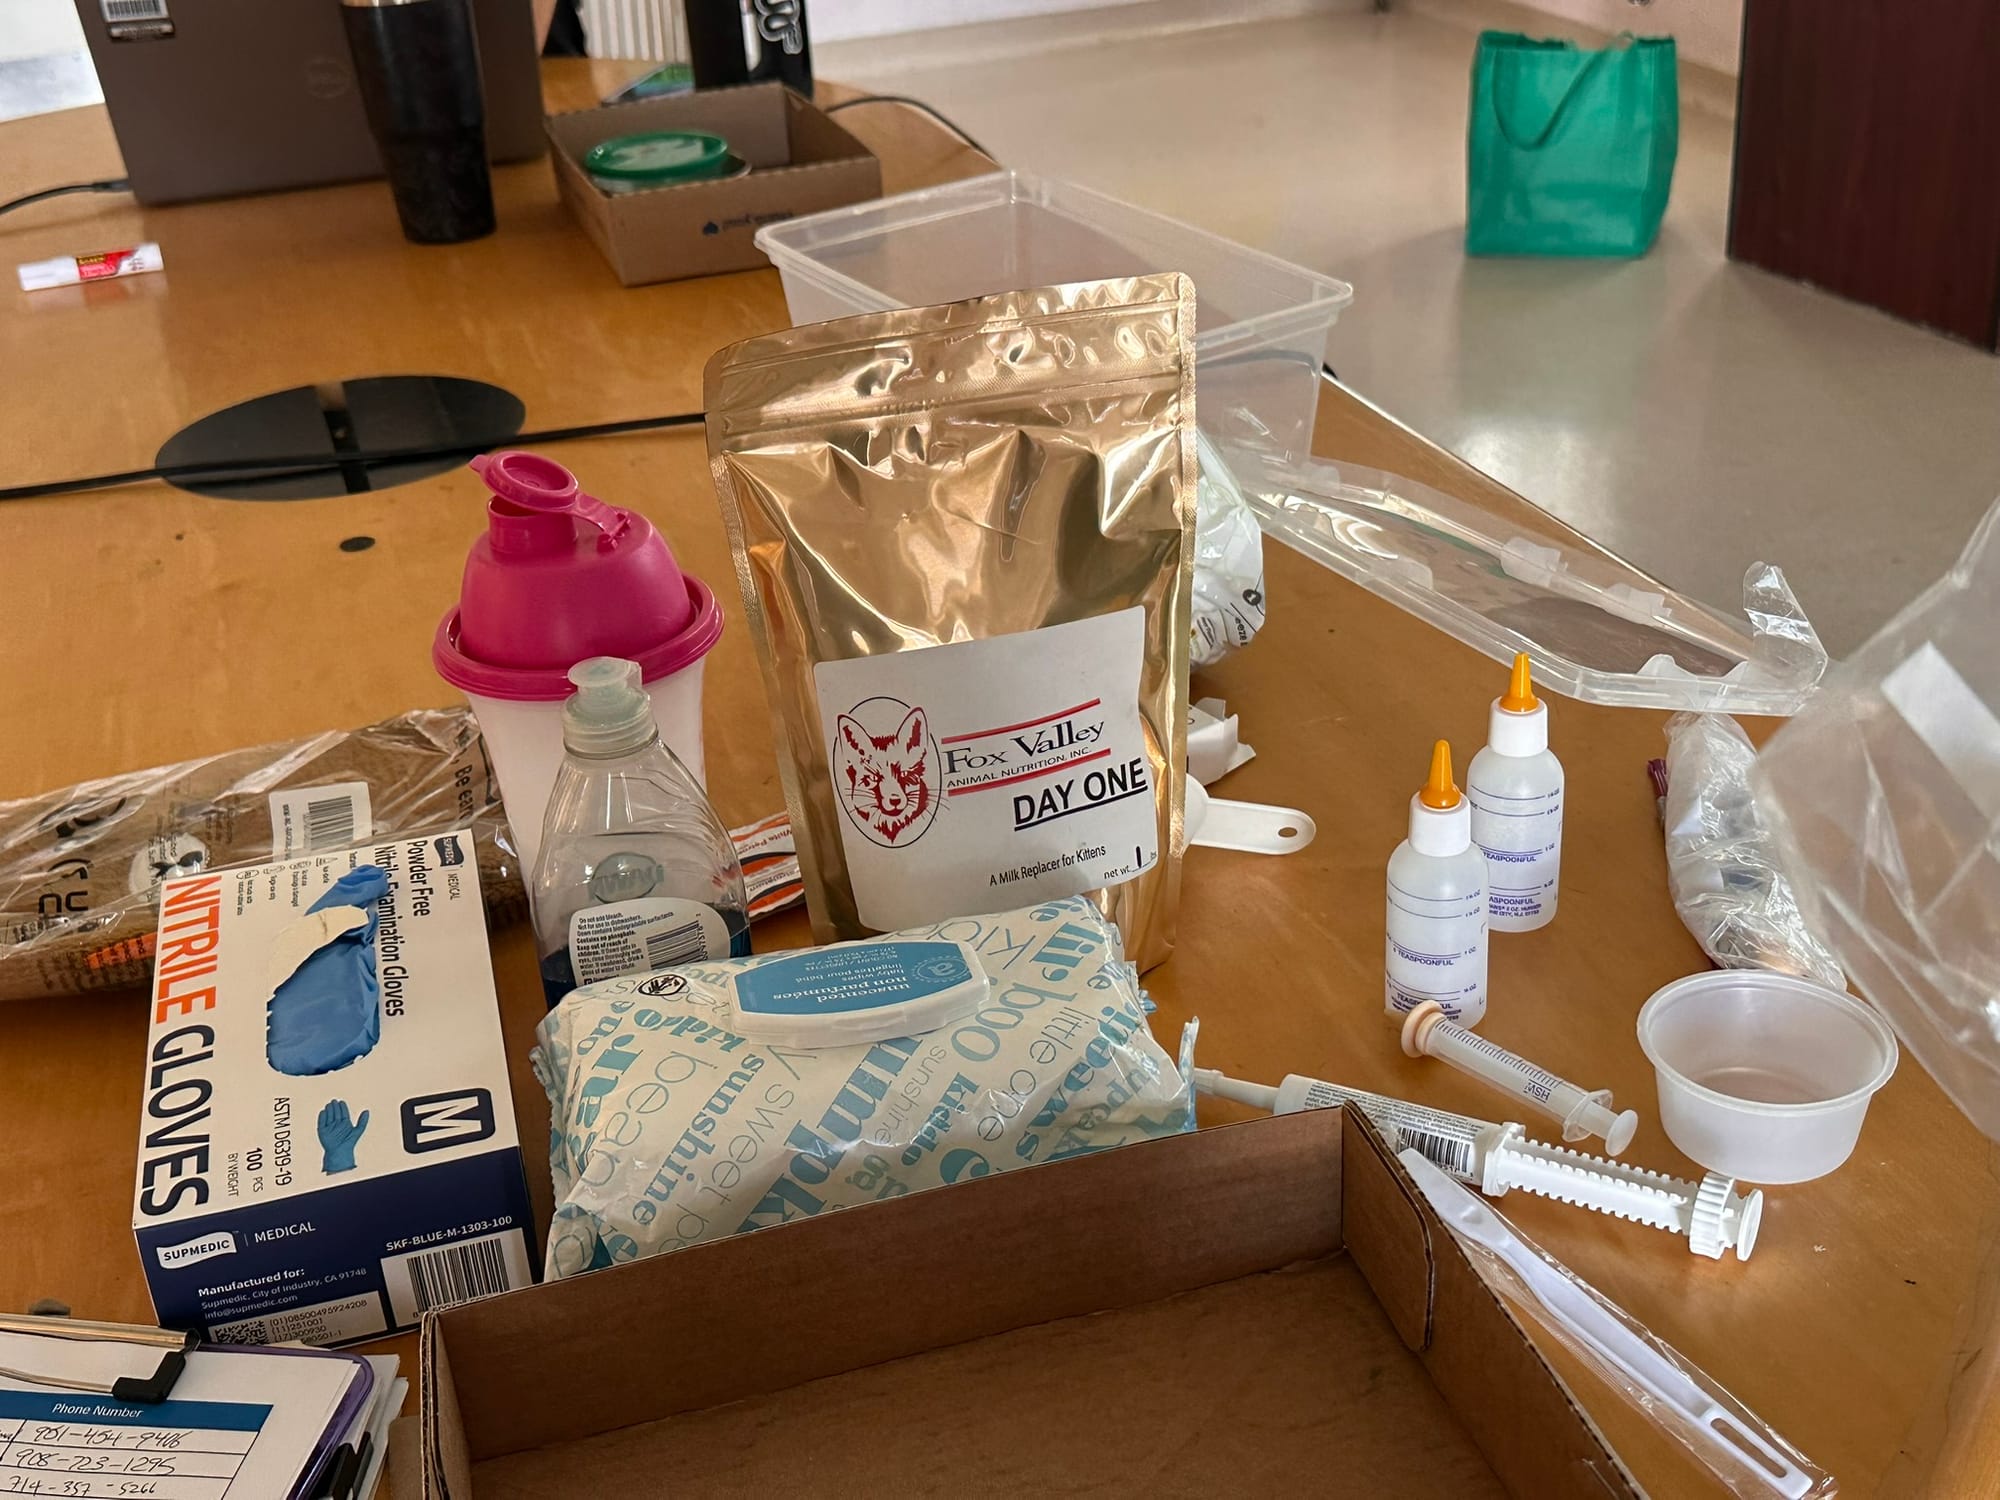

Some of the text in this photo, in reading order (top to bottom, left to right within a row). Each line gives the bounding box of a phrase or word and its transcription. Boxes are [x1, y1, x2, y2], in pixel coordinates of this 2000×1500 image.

[943, 719, 1104, 775] Fox Valley
[946, 772, 998, 788] ANIMAL
[1069, 746, 1093, 758] INC.
[1013, 757, 1147, 825] DAY ONE
[407, 839, 434, 917] Powder Free
[989, 844, 1106, 887] A Milk Replacer for Kittens
[1104, 868, 1118, 880] net
[1483, 851, 1537, 863] TEASPOONFUL
[1488, 896, 1534, 905] ASPOONFUL
[156, 875, 223, 1024] NITRILE
[1398, 949, 1454, 966] TEASPOONFUL
[382, 964, 408, 1017] Gloves
[773, 976, 908, 1000] non parfumées
[817, 983, 911, 1003] unscented
[841, 969, 905, 982] baby wipes
[951, 982, 1079, 1062] boo
[874, 1044, 948, 1144] sunshine
[977, 1006, 1096, 1141] little one
[140, 1024, 215, 1216] GLOVES
[274, 1097, 293, 1186] ASTM D6319-19
[413, 1095, 483, 1144] M
[632, 1053, 766, 1225] sunshine
[901, 1072, 979, 1167] kiddo
[699, 1083, 796, 1206] sweet
[227, 1153, 239, 1197] BY WEIGHT
[246, 1147, 264, 1193] 100 PCS
[164, 1221, 316, 1261] SUPMEDIC MEDICAL
[386, 1215, 512, 1251] SKF-BLUE-M-1303-100
[198, 1268, 305, 1297] Manufactured for:
[252, 1288, 270, 1300] City
[271, 1285, 281, 1295] of
[282, 1278, 323, 1294] Industry,
[324, 1274, 338, 1284] CA
[338, 1267, 367, 1281] 91748
[204, 1294, 298, 1320] info@supmedic.com
[52, 1402, 144, 1419] Phone Number
